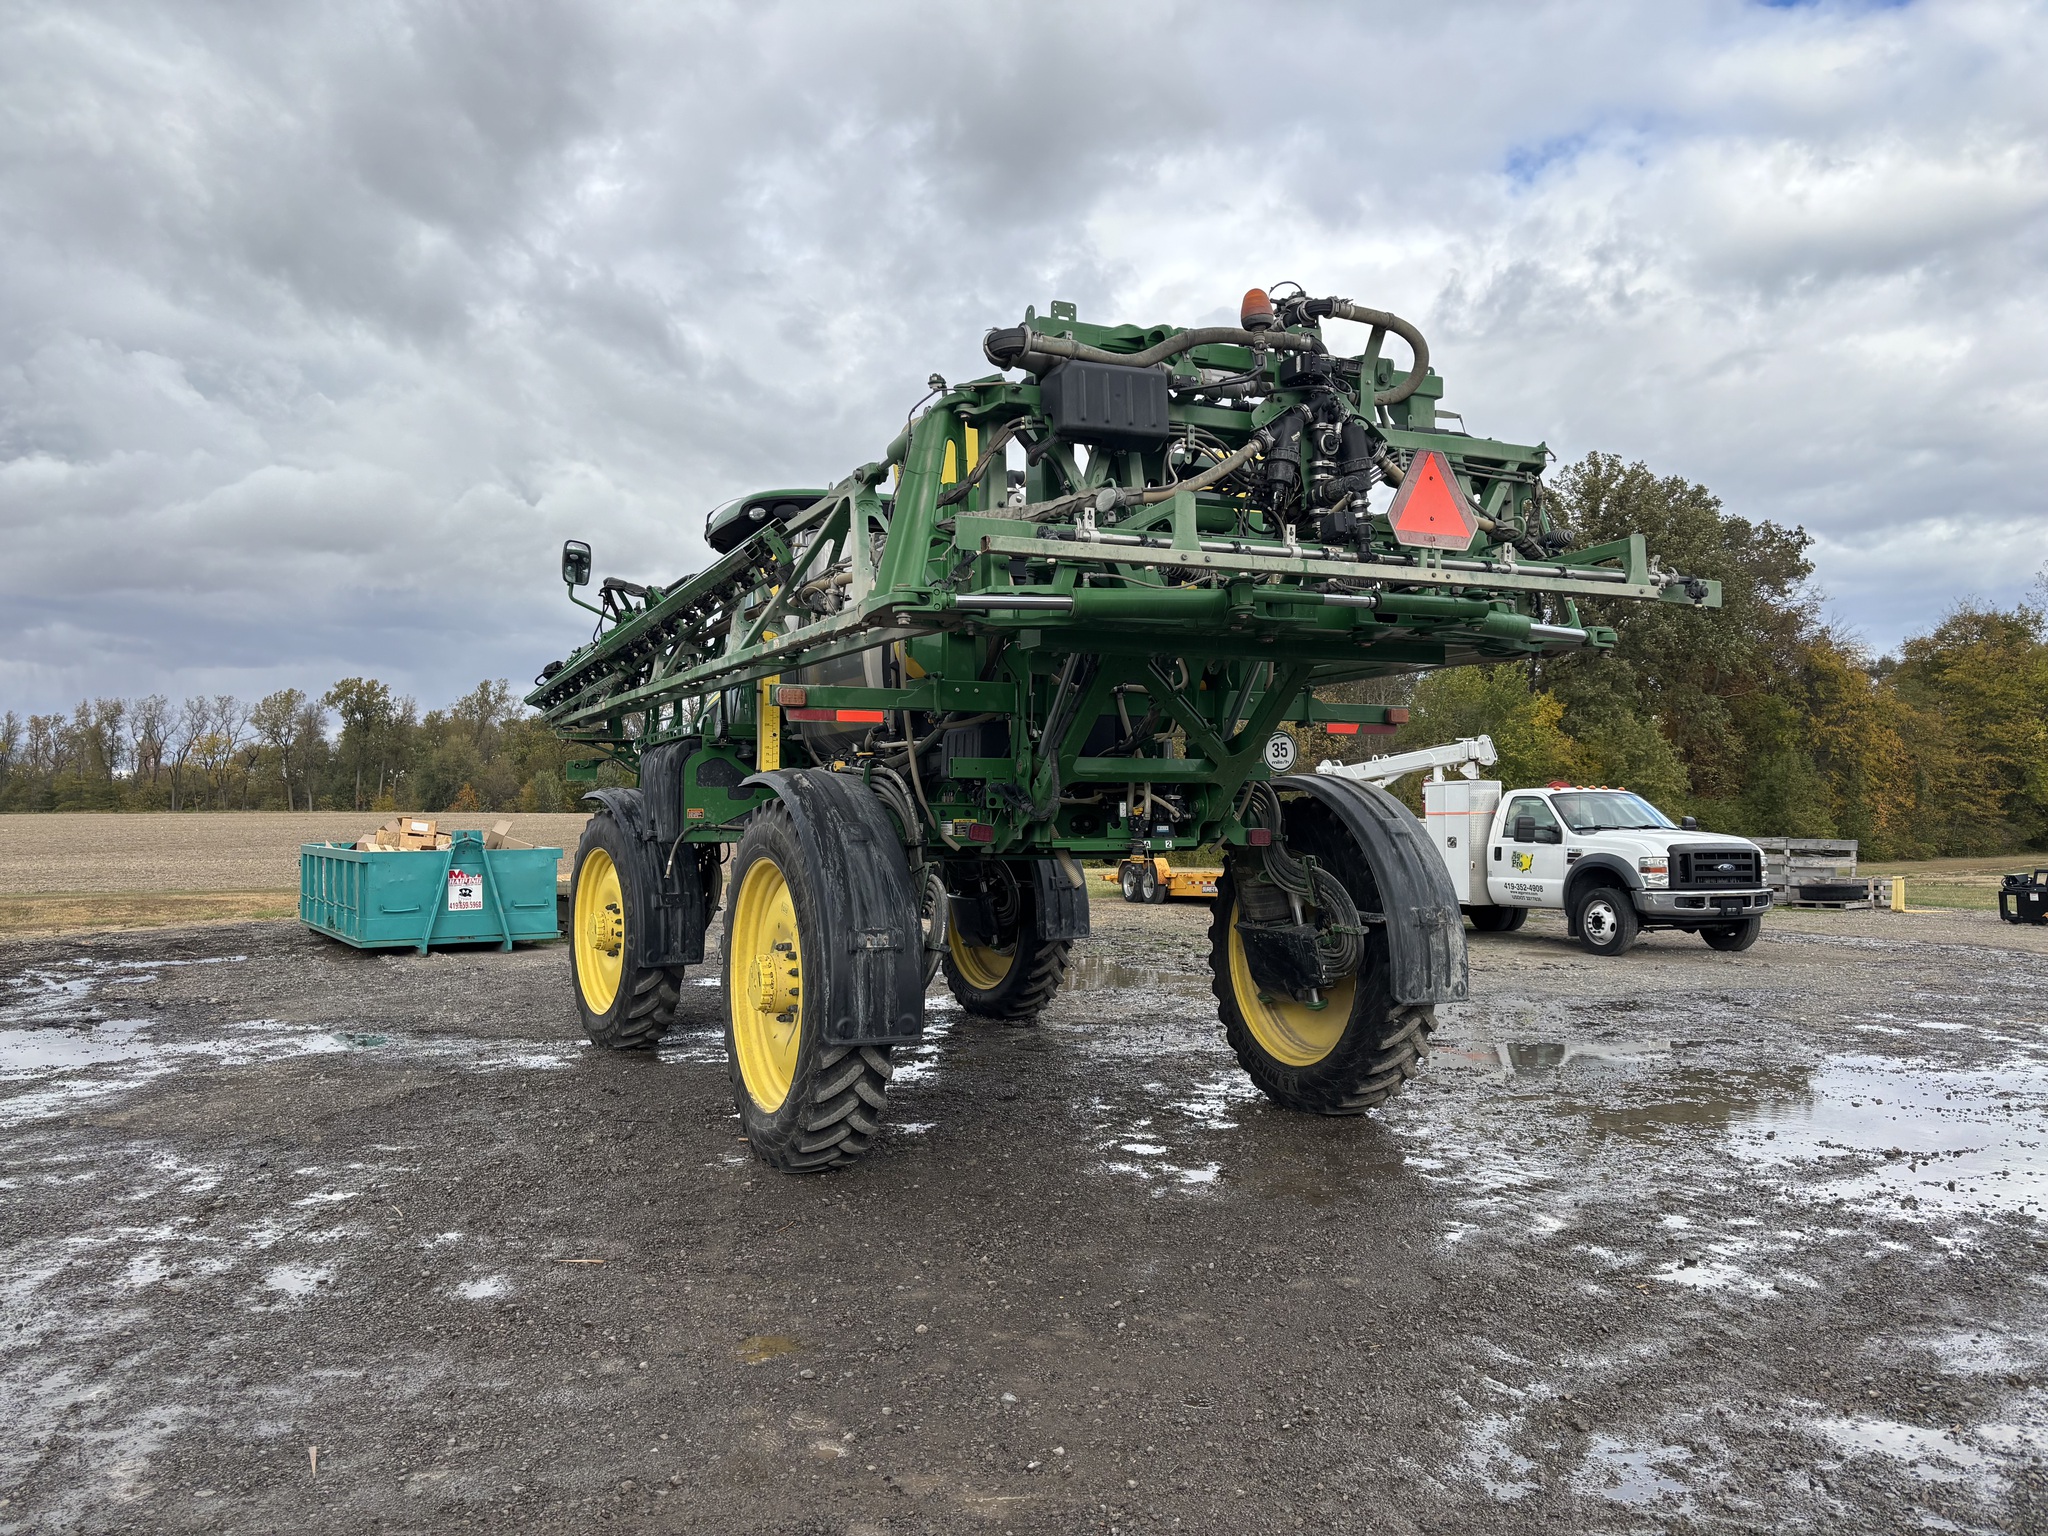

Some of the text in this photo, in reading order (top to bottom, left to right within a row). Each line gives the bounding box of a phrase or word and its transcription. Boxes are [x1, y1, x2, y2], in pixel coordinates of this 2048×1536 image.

[1271, 742, 1288, 759] 35
[1166, 840, 1171, 848] 2
[1511, 859, 1523, 868] Pro
[1503, 883, 1544, 893] 419-352-4908
[449, 901, 482, 909] 419.659.5968
